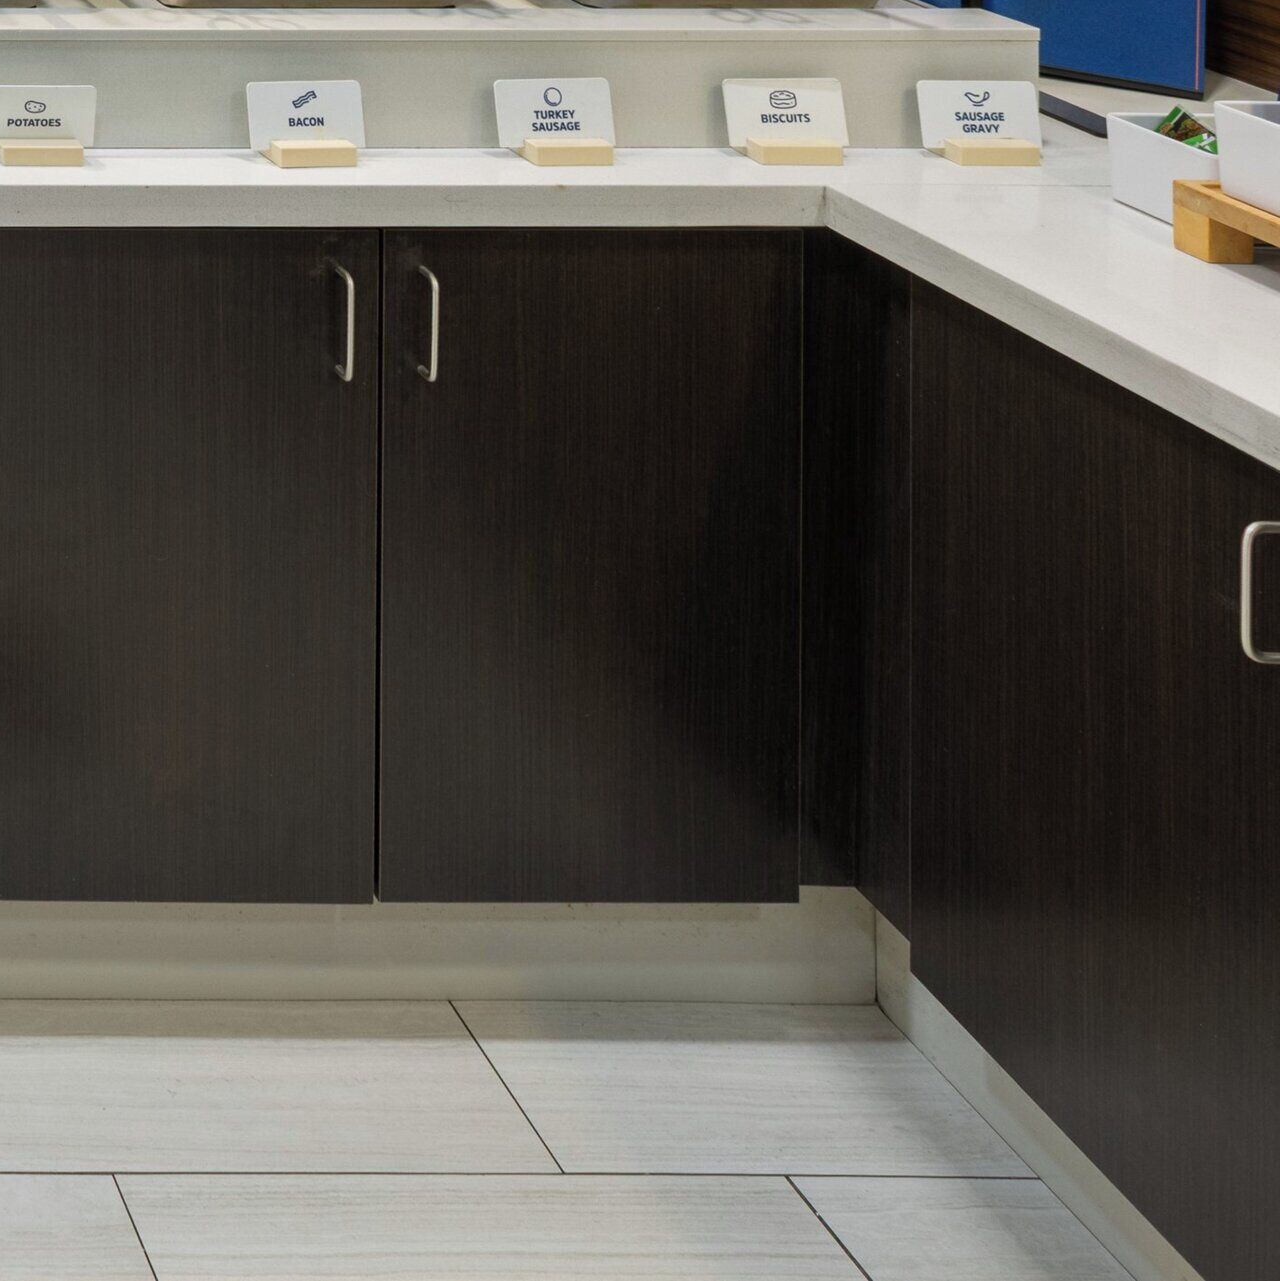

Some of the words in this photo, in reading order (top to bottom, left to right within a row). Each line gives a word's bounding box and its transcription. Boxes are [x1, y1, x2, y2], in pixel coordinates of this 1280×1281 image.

[533, 109, 576, 120] TURKEY
[760, 113, 811, 124] BISCUITS
[954, 111, 1005, 122] SAUSAGE
[6, 117, 62, 127] POTATOES
[288, 117, 325, 127] BACON
[531, 121, 581, 131] SAUSAGE
[962, 123, 1000, 134] GRAVY
